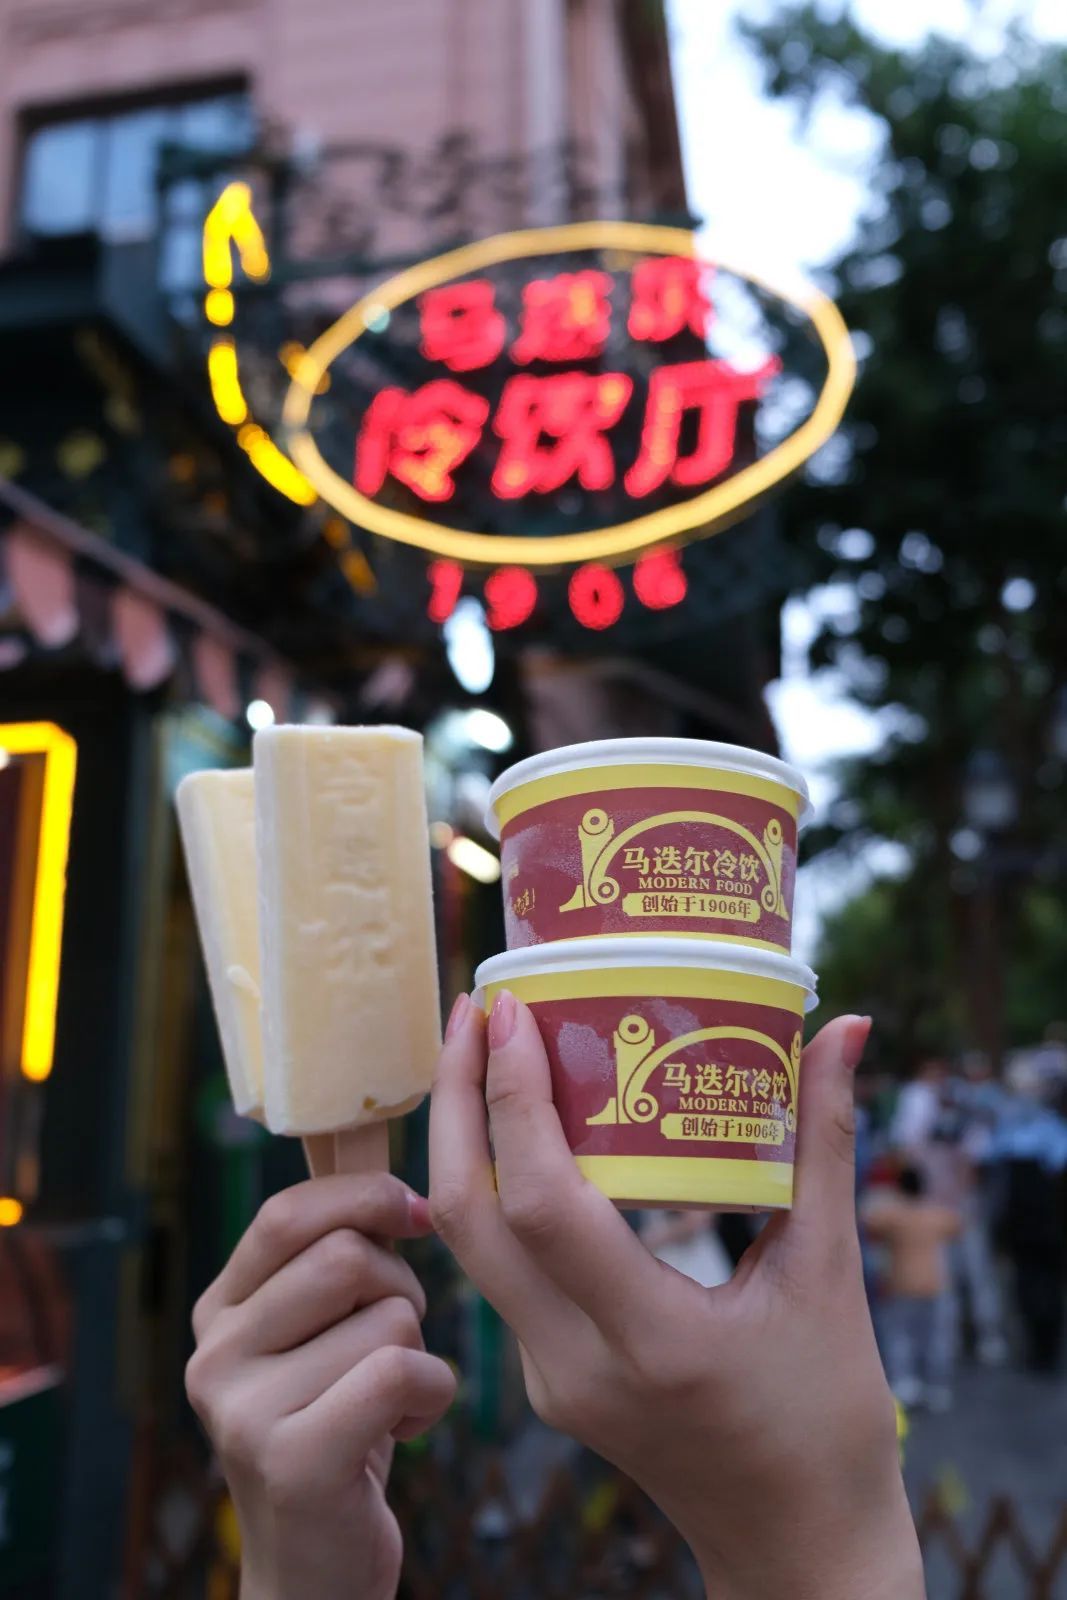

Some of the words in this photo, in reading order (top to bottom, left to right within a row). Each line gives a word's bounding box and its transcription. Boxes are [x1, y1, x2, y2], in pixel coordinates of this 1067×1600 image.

[355, 356, 782, 501] 冷饮厅
[427, 545, 687, 630] 1906
[622, 846, 760, 883] 马迭尔冷饮
[639, 876, 710, 890] MODERN
[716, 879, 752, 895] FOOD
[642, 895, 751, 918] 创始于1906年
[662, 1062, 787, 1102] 马迭尔冷饮
[680, 1097, 748, 1113] MODERN
[682, 1117, 779, 1141] 创始于1906年
